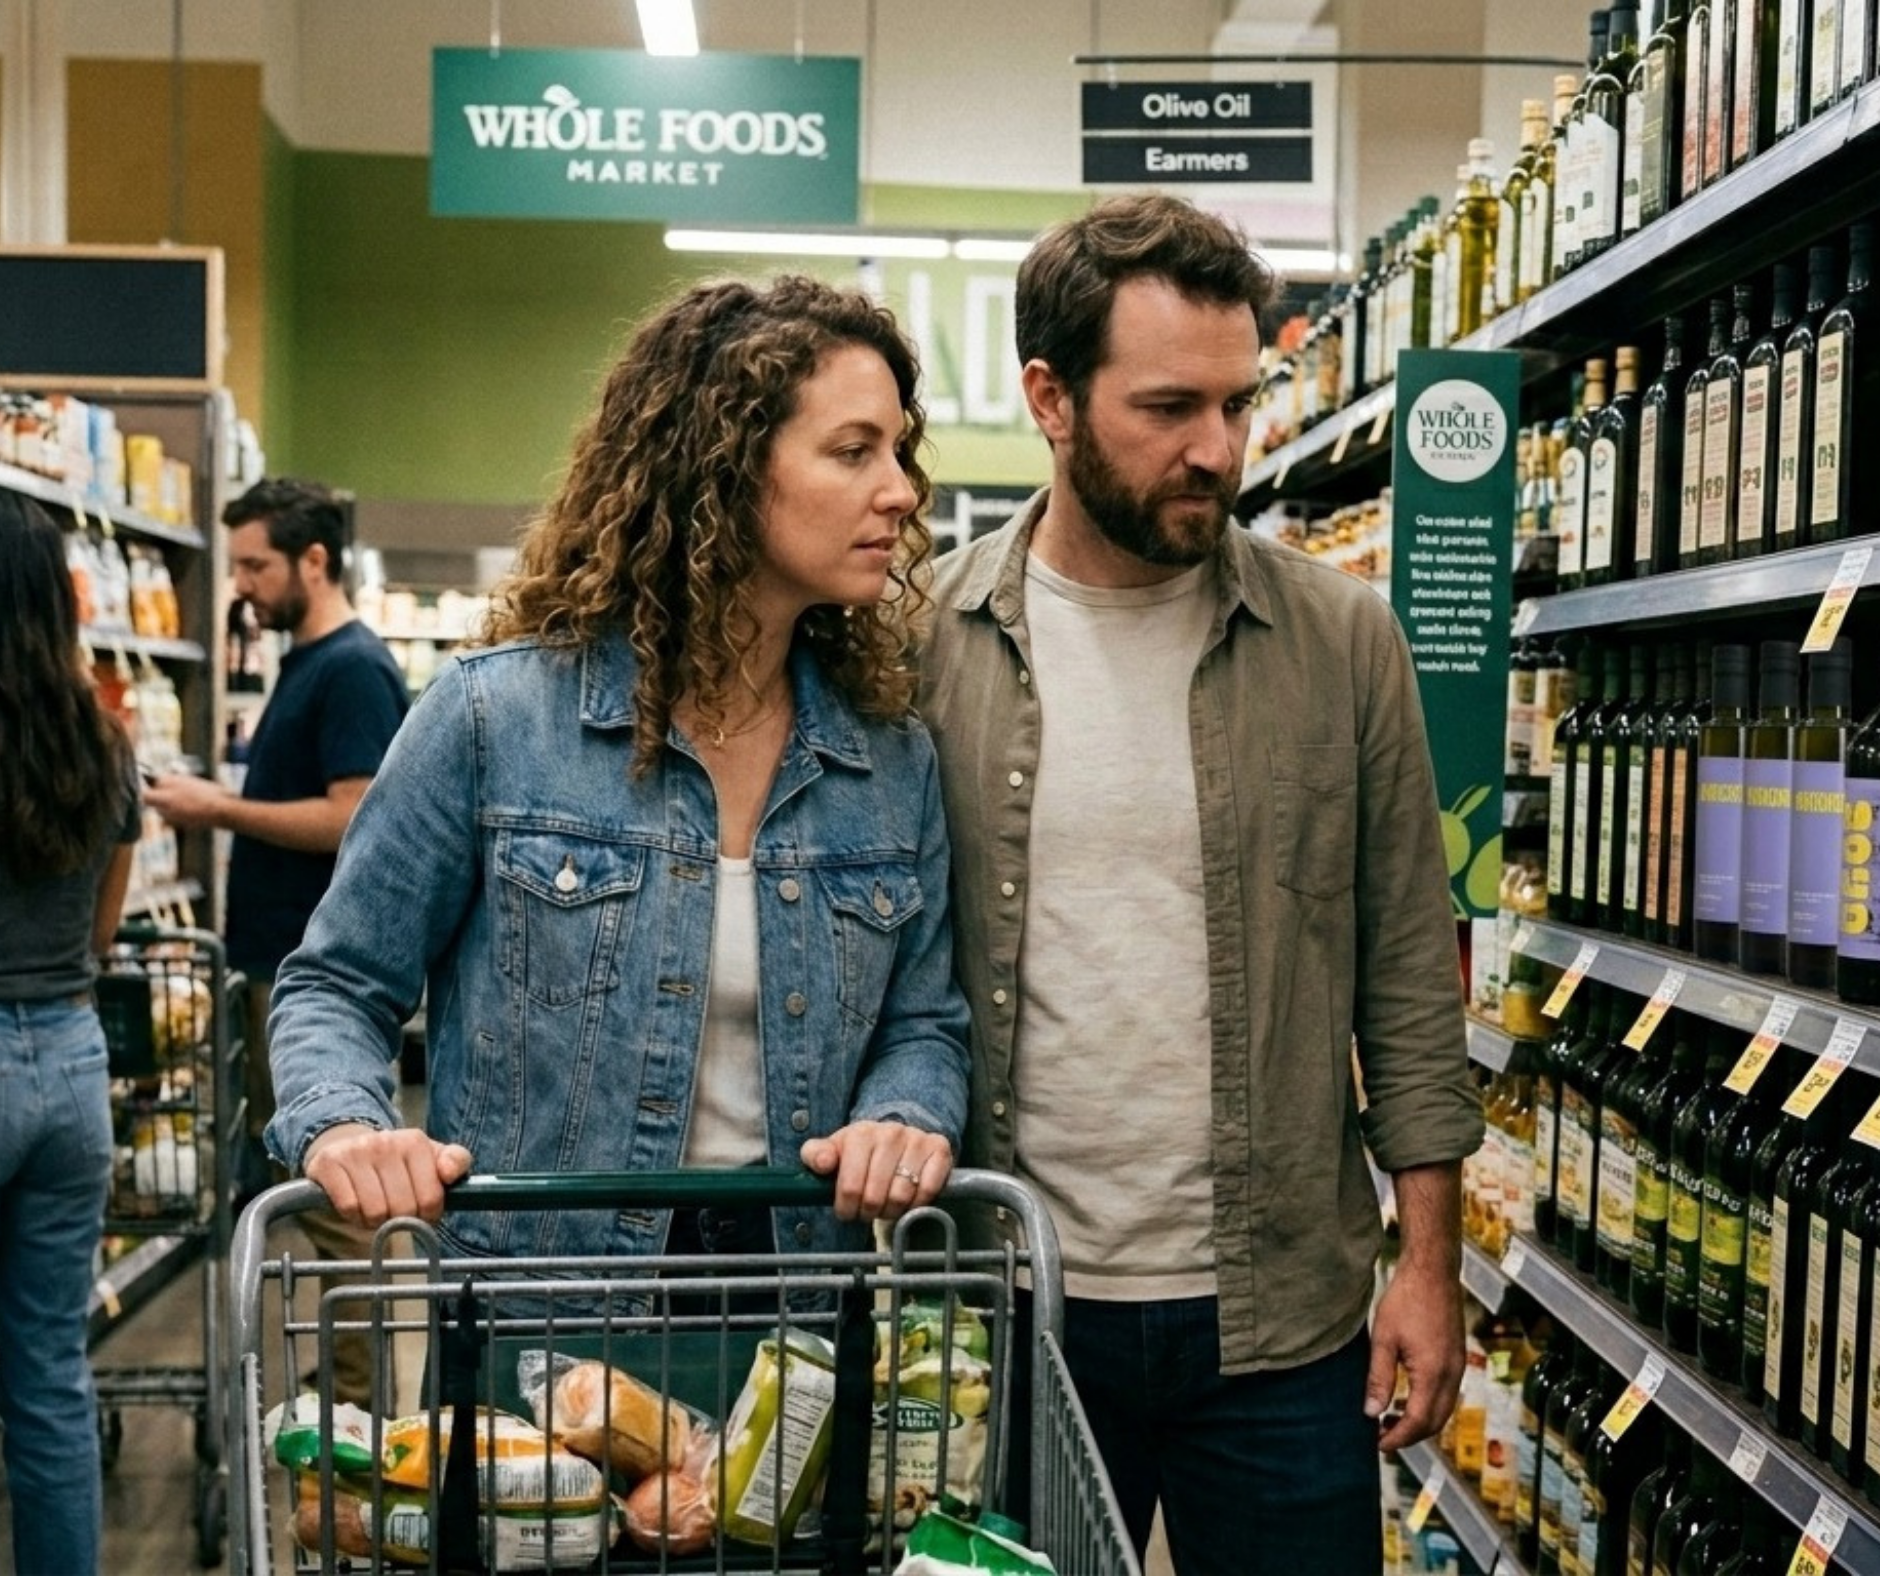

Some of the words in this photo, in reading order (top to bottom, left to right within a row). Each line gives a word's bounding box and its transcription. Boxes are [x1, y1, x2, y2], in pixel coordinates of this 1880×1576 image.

[1213, 93, 1251, 118] Oil
[463, 104, 646, 150] WHOLE
[658, 109, 826, 157] FOODS
[1145, 147, 1249, 171] Earmers
[566, 160, 724, 185] MARKET
[1420, 431, 1493, 450] FOODS
